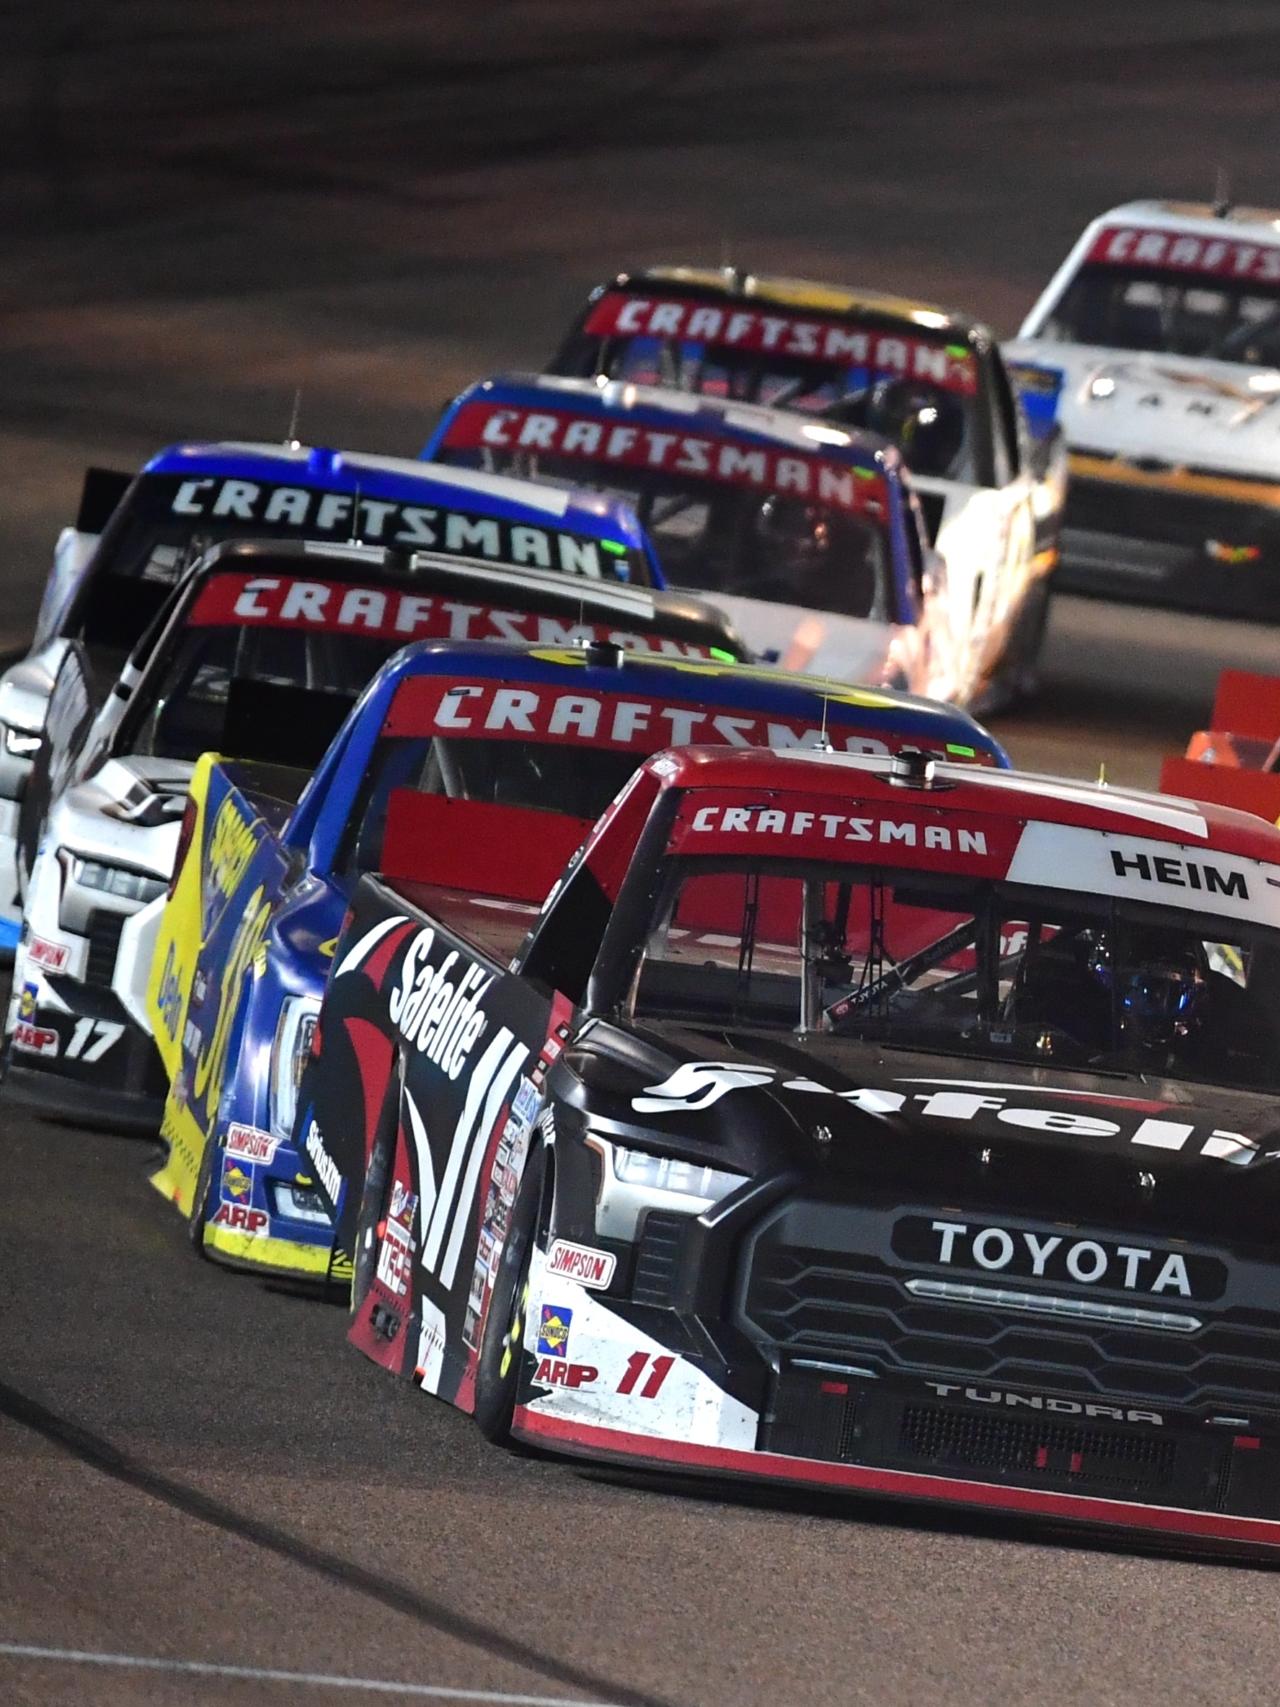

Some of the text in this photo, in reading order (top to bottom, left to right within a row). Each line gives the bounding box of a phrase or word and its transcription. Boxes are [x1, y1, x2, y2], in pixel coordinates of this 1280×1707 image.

[615, 300, 948, 382] CRAFTSMAN
[482, 410, 855, 504] CRAFTSMAN
[171, 479, 602, 581] CRAFTSMAN
[432, 686, 948, 762] CRAFTSM
[691, 807, 1250, 901] CRAFTSMAN HEIM
[389, 927, 496, 1080] Safelite
[64, 1017, 126, 1063] 17
[229, 1128, 273, 1158] SIMPSON
[213, 1203, 268, 1232] ARP
[550, 1246, 607, 1281] SIMPSON
[931, 1220, 1192, 1297] TOYOTA
[534, 1357, 599, 1389] ARP
[615, 1350, 676, 1399] 11
[924, 1380, 1164, 1427] TUNDRA
